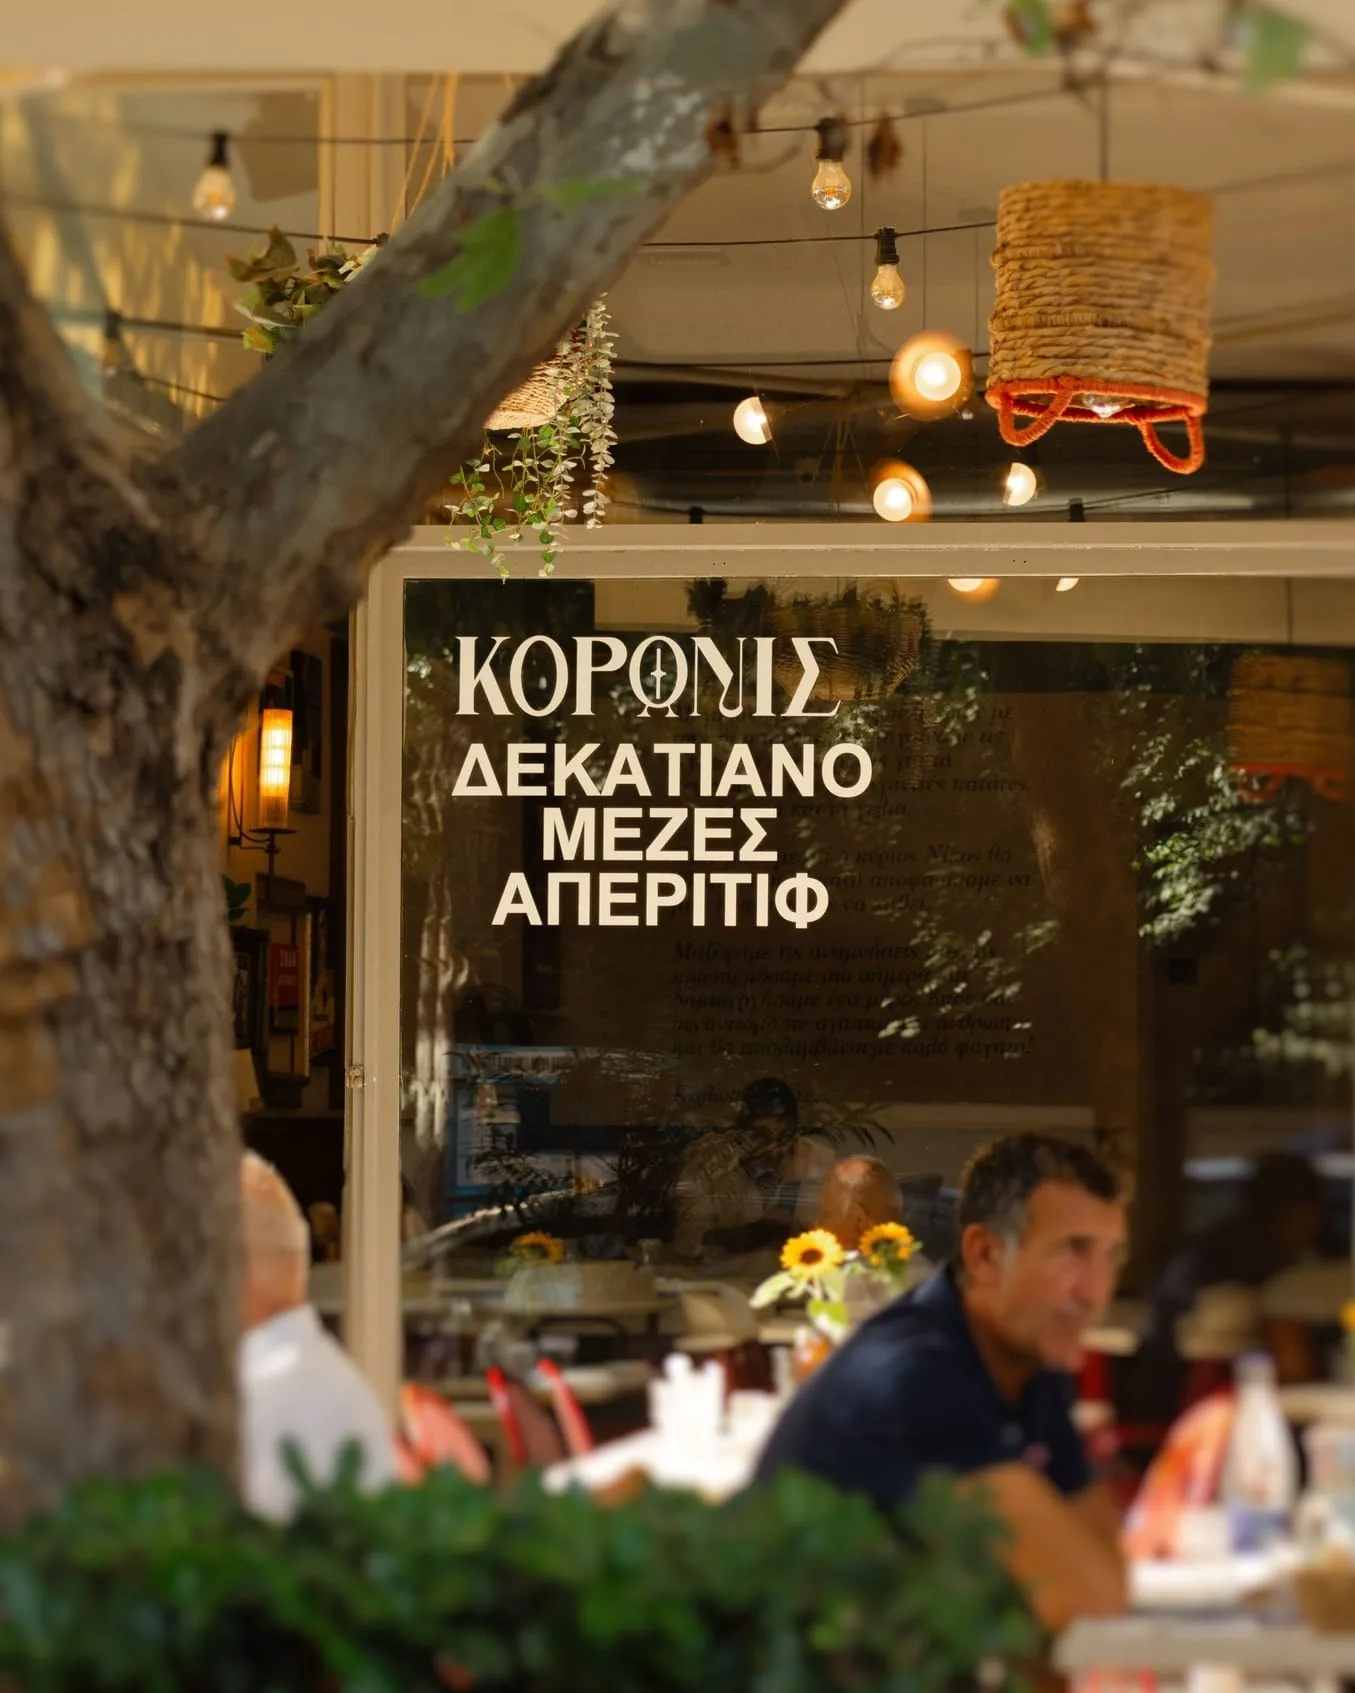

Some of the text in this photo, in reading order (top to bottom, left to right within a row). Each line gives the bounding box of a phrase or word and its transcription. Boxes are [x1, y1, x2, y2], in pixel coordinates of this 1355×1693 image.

[456, 635, 841, 718] ΚΟΡΩΝΙΣ
[451, 742, 873, 798] ΔΕΚΑΤΙΑΝΟ
[542, 807, 778, 862] ΜΕΖΕΣ
[491, 872, 829, 929] ΑΠΕΡΙΤΙΦ
